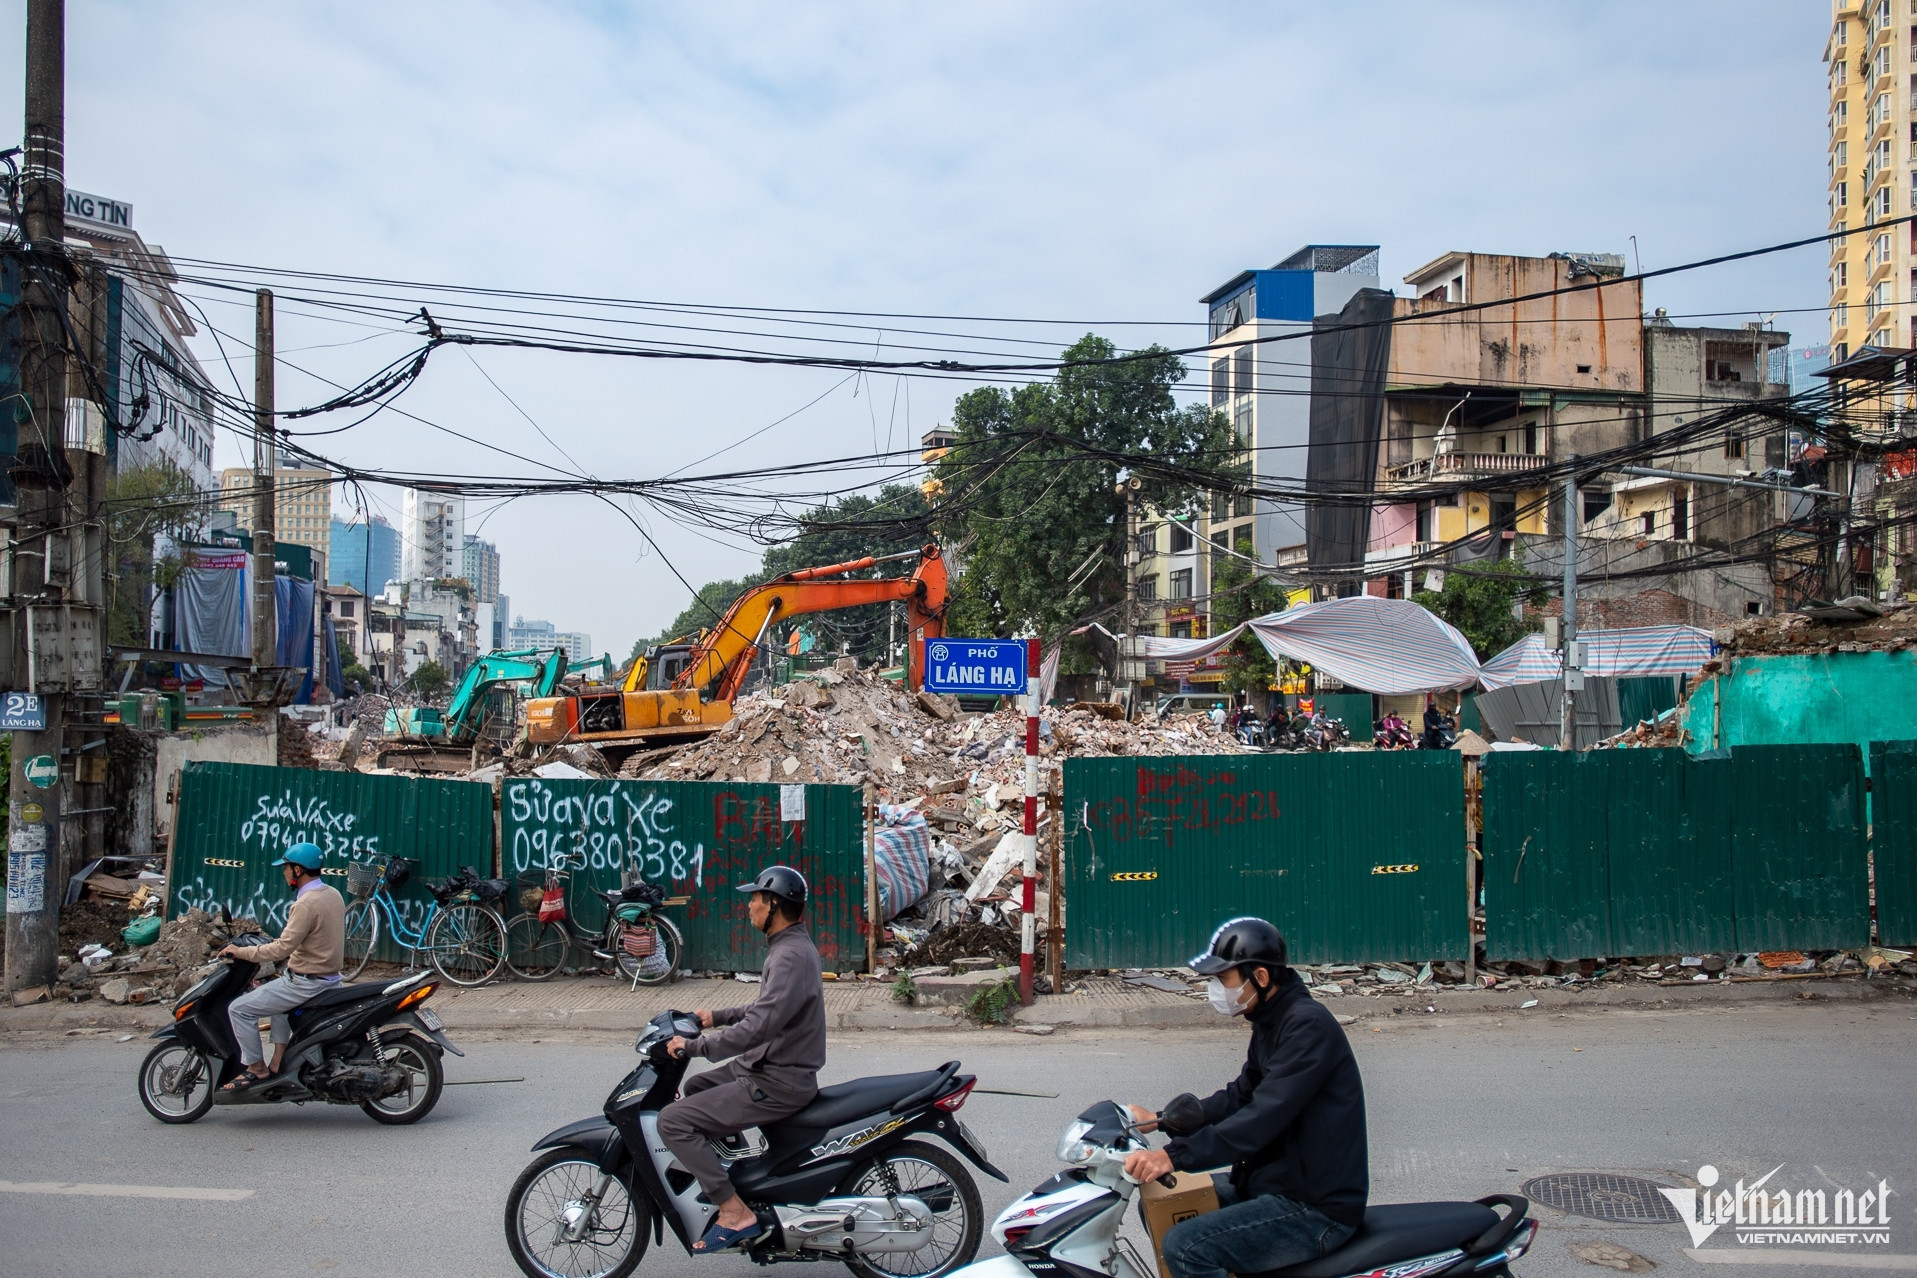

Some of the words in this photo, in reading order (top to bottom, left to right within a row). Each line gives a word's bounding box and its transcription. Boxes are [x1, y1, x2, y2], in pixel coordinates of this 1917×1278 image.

[64, 193, 94, 217] NG
[968, 646, 999, 659] PHỐ
[935, 662, 985, 684] LÁNG
[990, 667, 1016, 688] HẠ
[6, 695, 38, 717] 2E
[2, 718, 27, 727] LÁNG
[28, 720, 42, 728] HẠ
